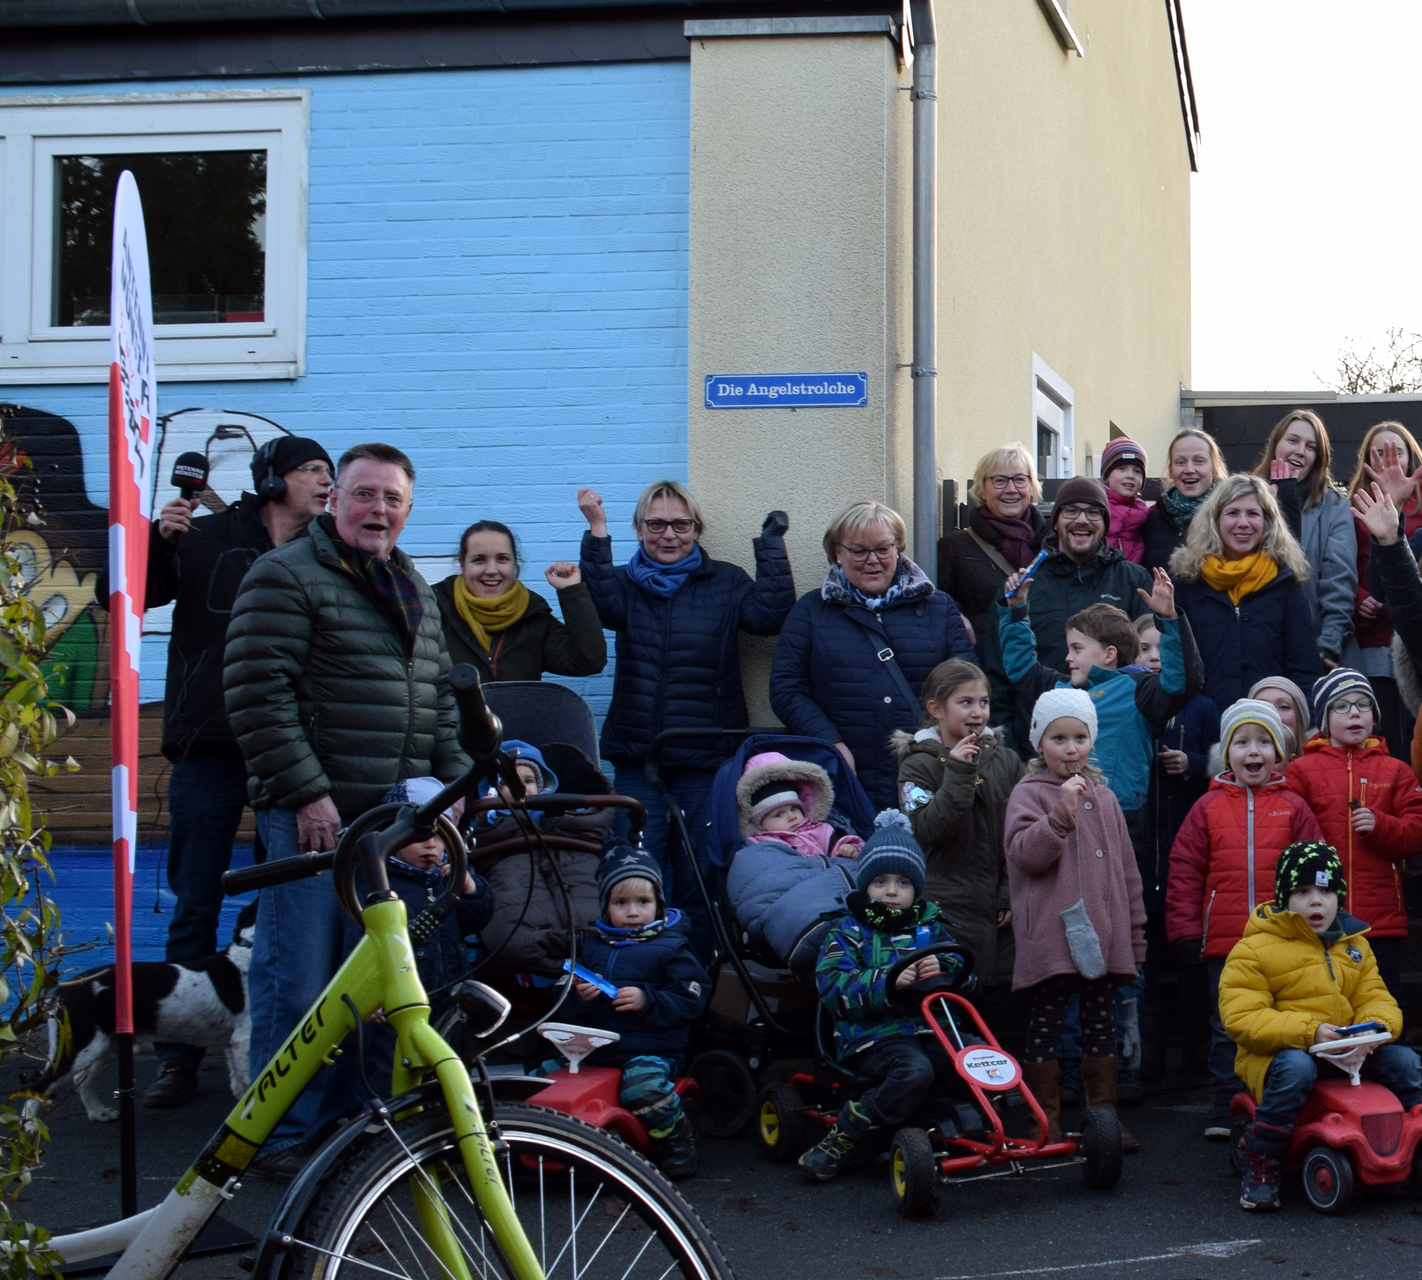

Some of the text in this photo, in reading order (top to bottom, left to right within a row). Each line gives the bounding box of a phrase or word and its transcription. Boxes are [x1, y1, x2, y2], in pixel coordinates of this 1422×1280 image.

[717, 382, 856, 399] Die Angelstrolche
[240, 996, 328, 1121] FALTER
[966, 1059, 1008, 1069] Kettcar
